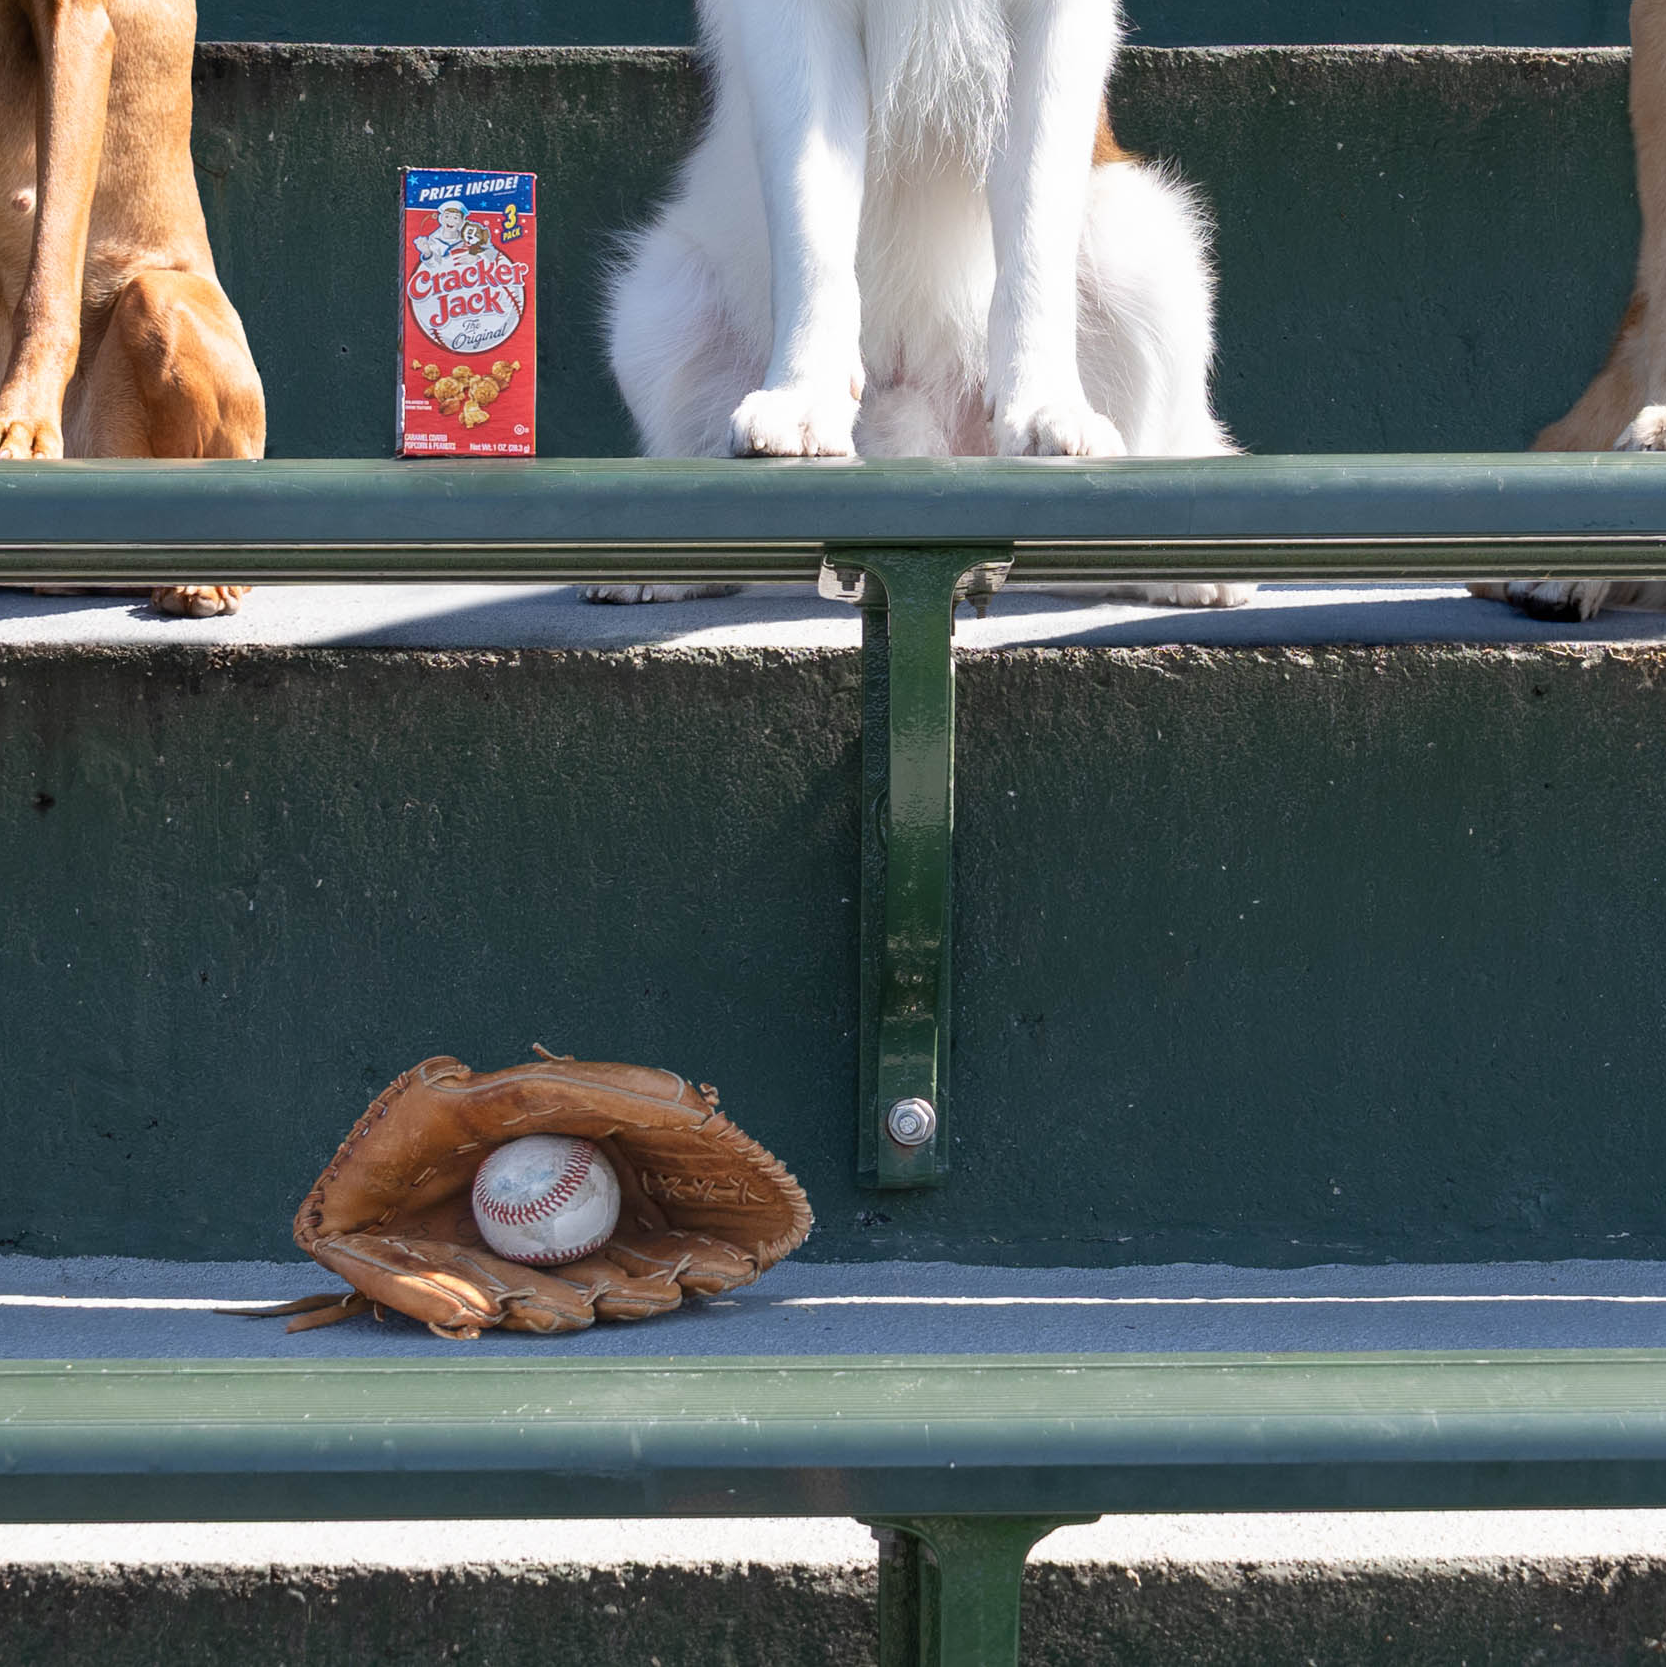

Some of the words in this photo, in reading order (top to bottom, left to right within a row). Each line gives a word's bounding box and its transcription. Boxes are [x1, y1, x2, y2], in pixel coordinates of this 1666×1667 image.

[419, 184, 463, 202] PRIZE
[465, 175, 519, 196] INSIDE!
[504, 204, 517, 229] 3
[502, 227, 521, 241] PACK
[409, 259, 528, 300] Cracker
[429, 286, 505, 327] Jack
[452, 322, 508, 350] Original
[462, 319, 481, 333] The
